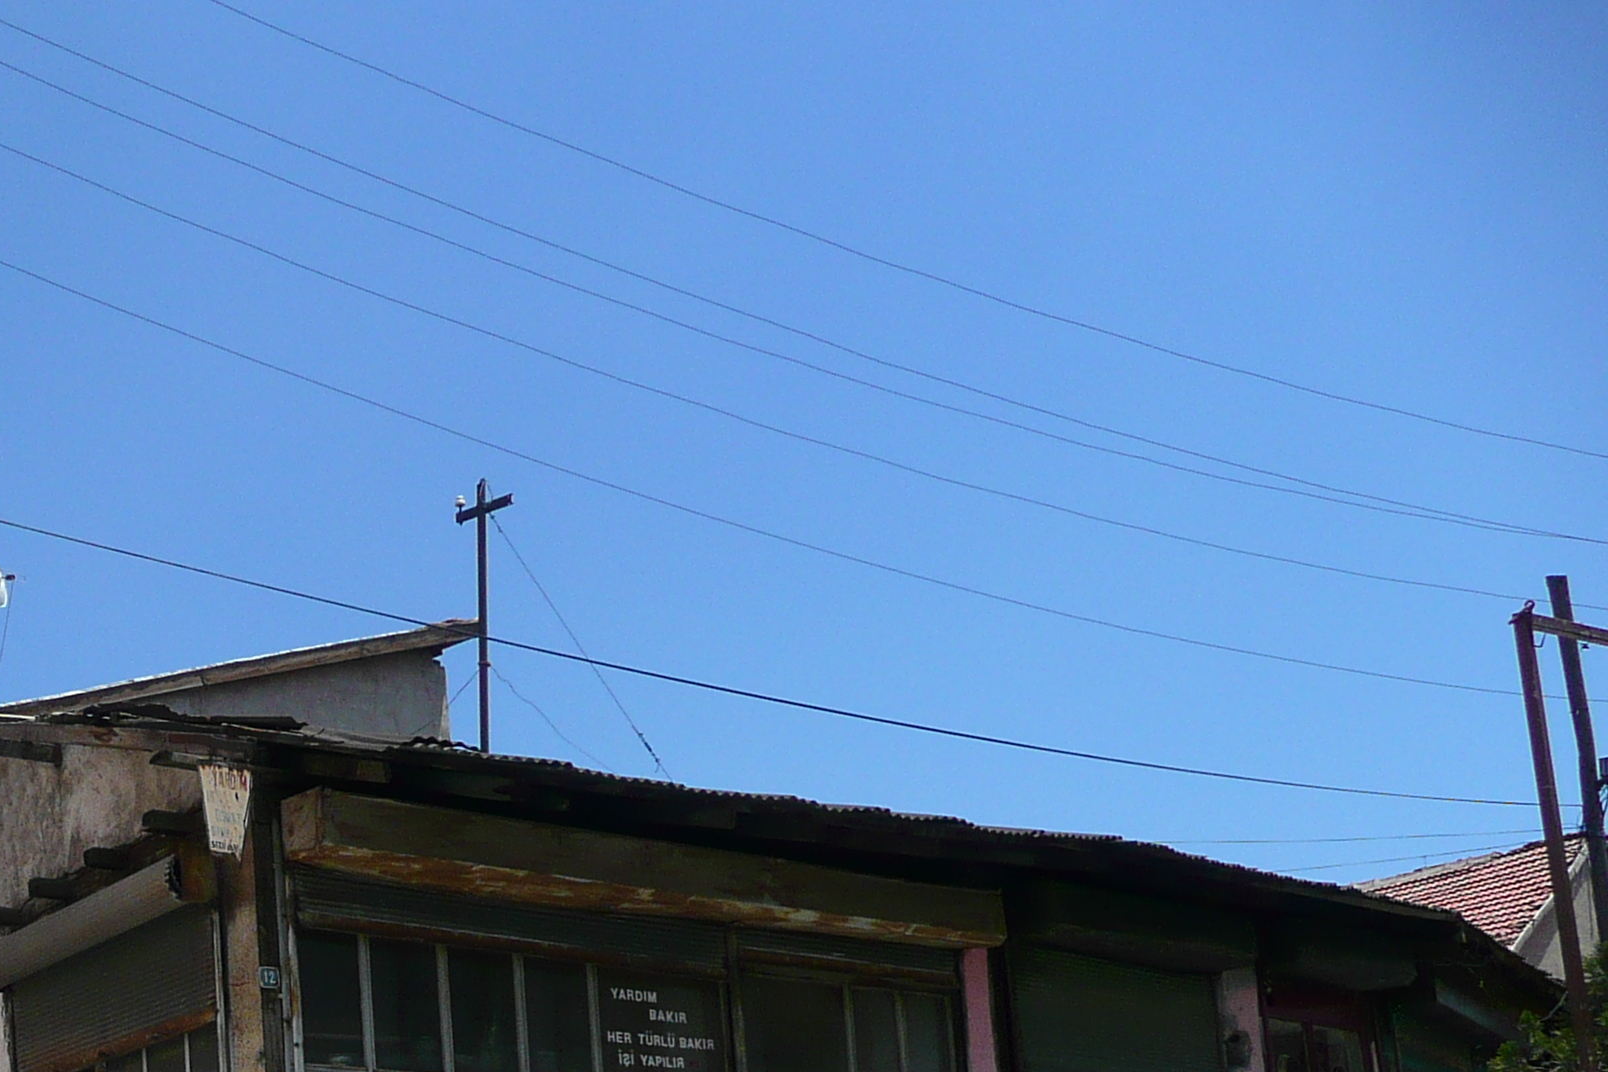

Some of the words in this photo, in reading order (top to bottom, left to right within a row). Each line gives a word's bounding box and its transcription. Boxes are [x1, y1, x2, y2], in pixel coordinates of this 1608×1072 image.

[264, 970, 276, 984] 12
[610, 987, 657, 1003] YARDIM
[649, 1008, 688, 1024] BAKIR
[607, 1030, 632, 1044] HER
[638, 1030, 675, 1047] TÜRLÜ
[679, 1037, 715, 1051] BAKIR
[618, 1050, 635, 1067] İŞİ
[640, 1054, 685, 1069] YAPILIR
